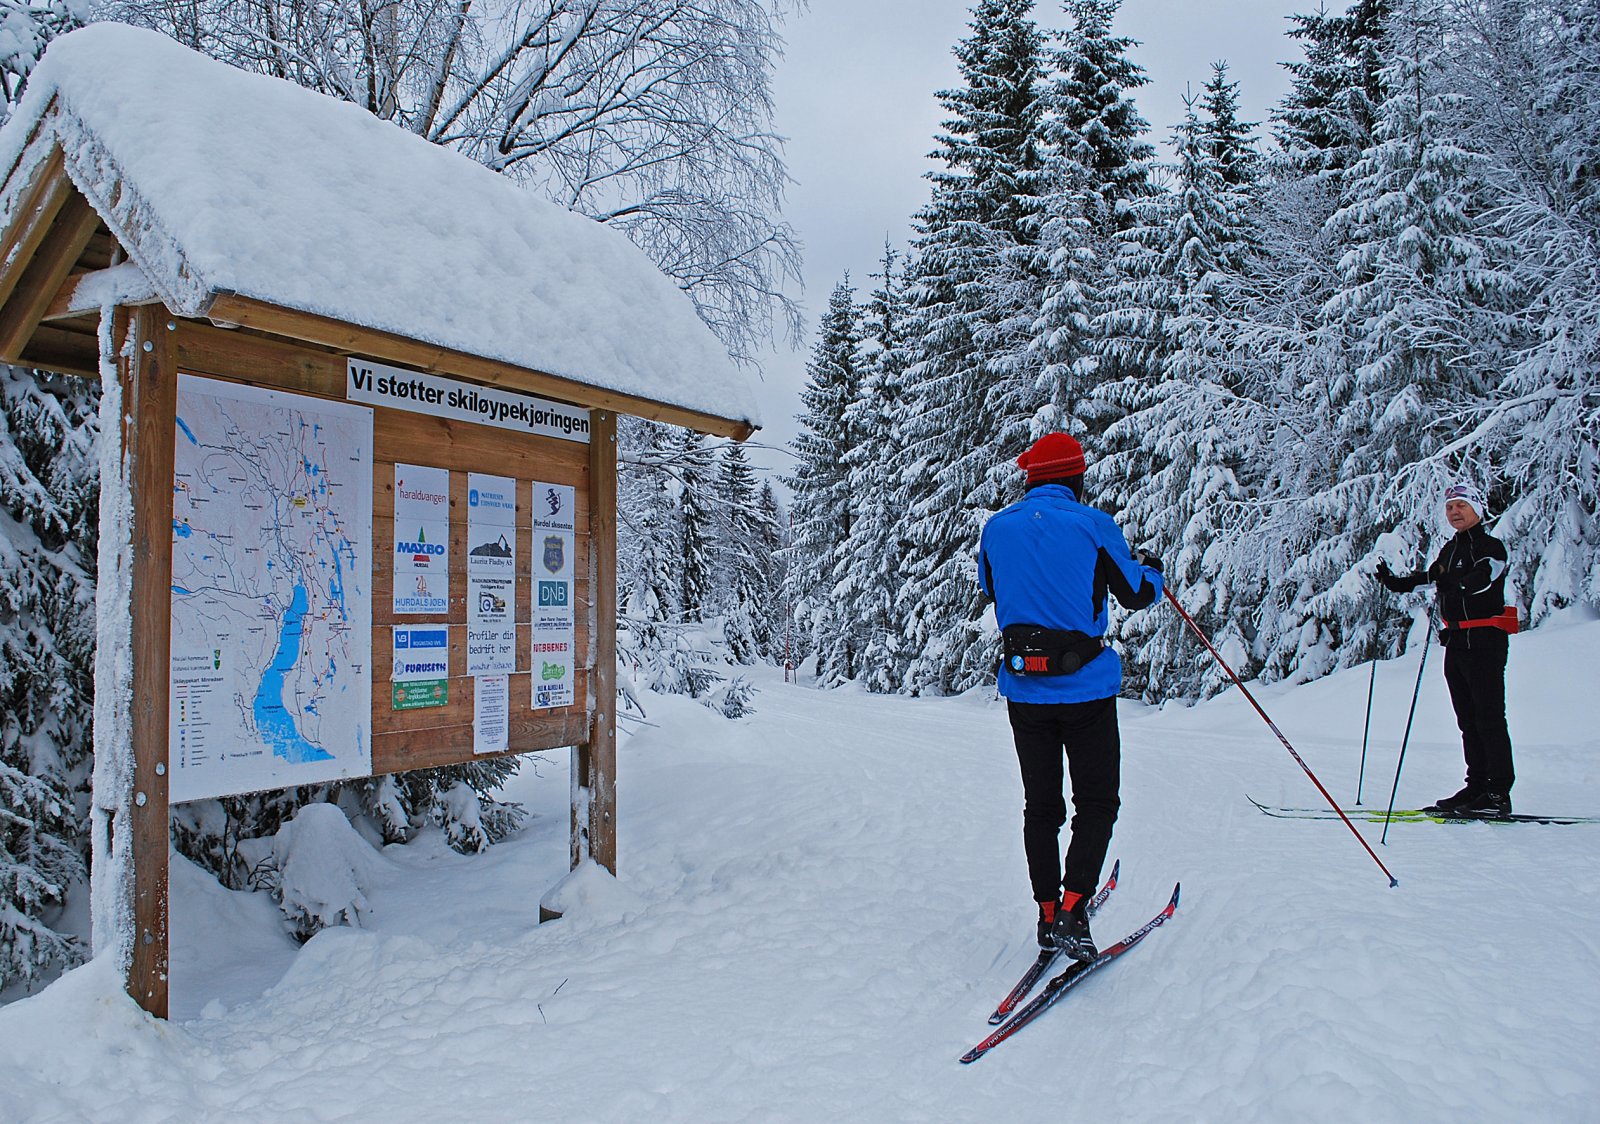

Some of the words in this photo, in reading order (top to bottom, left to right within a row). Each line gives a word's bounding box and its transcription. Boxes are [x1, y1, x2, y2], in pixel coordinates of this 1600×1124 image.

[350, 366, 373, 391] Vi
[377, 374, 444, 405] støtter
[447, 388, 589, 434] skiløypekjøringen
[399, 488, 447, 505] haraldvangen
[533, 519, 551, 528] Hurdal
[396, 541, 445, 556] MAXBO
[541, 583, 566, 604] DNB
[468, 631, 499, 641] Profiler
[502, 630, 514, 640] din
[469, 644, 496, 655] bedrift
[499, 644, 511, 654] her
[405, 662, 447, 674] FURUSETH
[1024, 656, 1049, 672] SWIX
